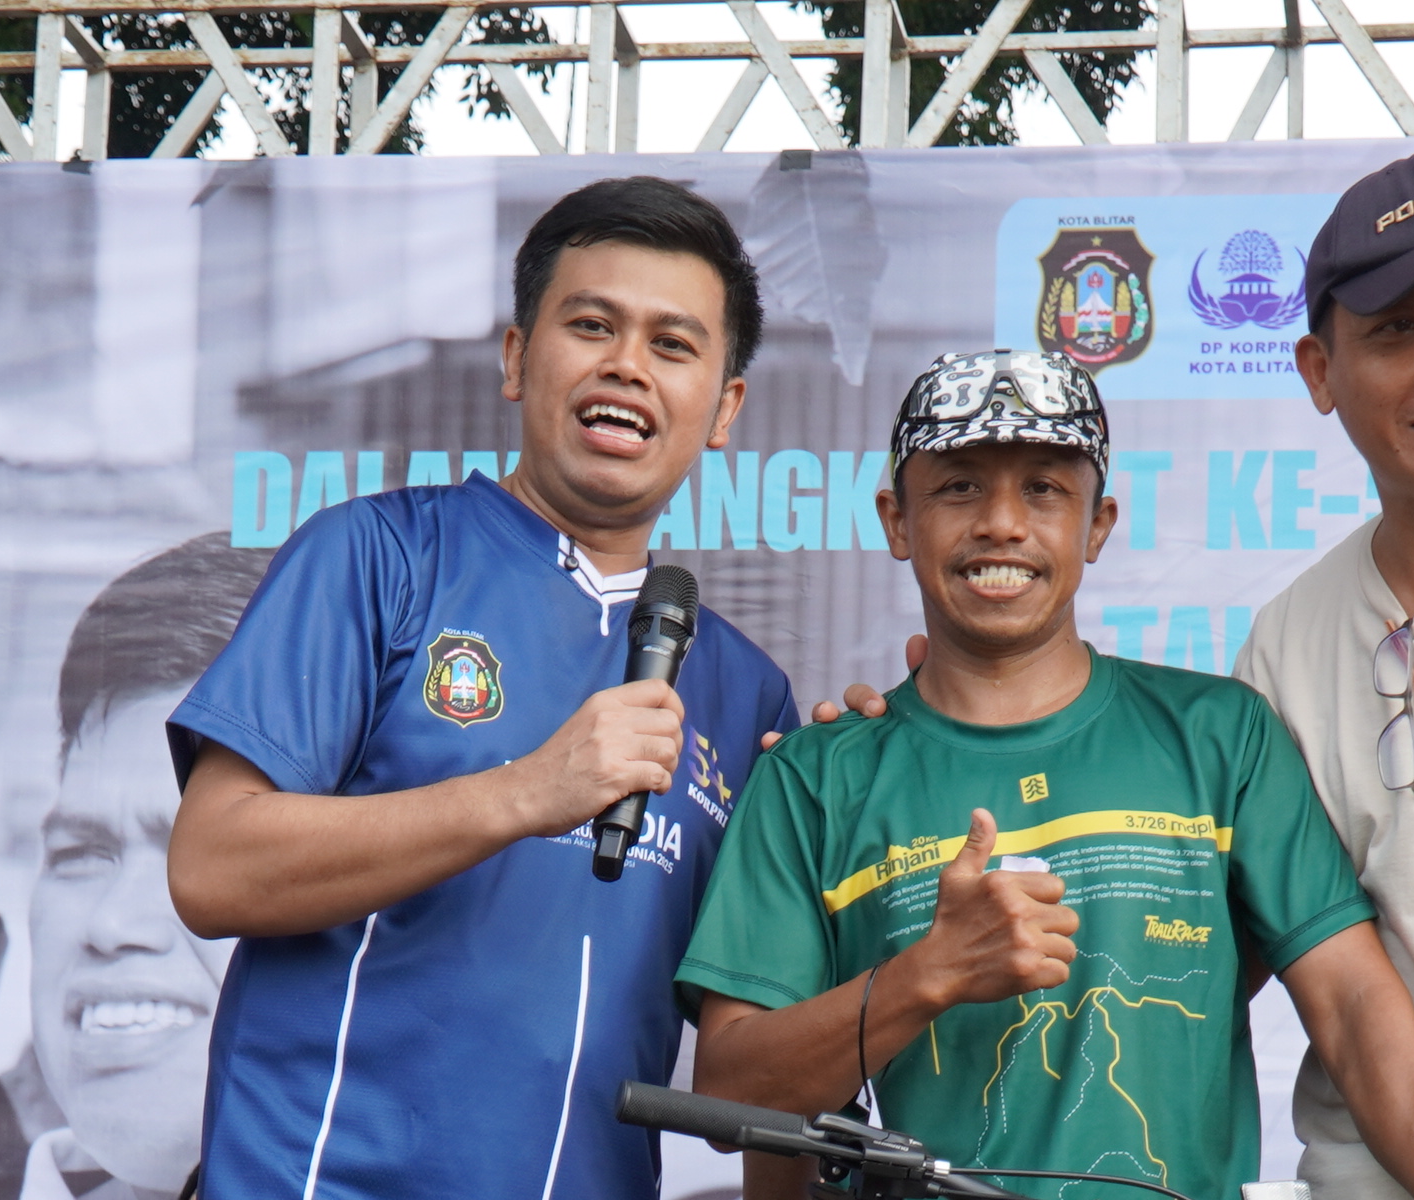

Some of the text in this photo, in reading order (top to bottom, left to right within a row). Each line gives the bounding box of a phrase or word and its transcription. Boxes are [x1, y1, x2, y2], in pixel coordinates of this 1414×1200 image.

[1058, 215, 1136, 226] KOTA BLITAR
[1201, 341, 1296, 354] DP KORPRI
[1190, 361, 1298, 374] KOTA BLITA
[687, 782, 729, 829] KORPRI
[1125, 814, 1214, 839] 3.726 mdpl
[911, 836, 925, 847] 20
[875, 842, 941, 882] Rinjani
